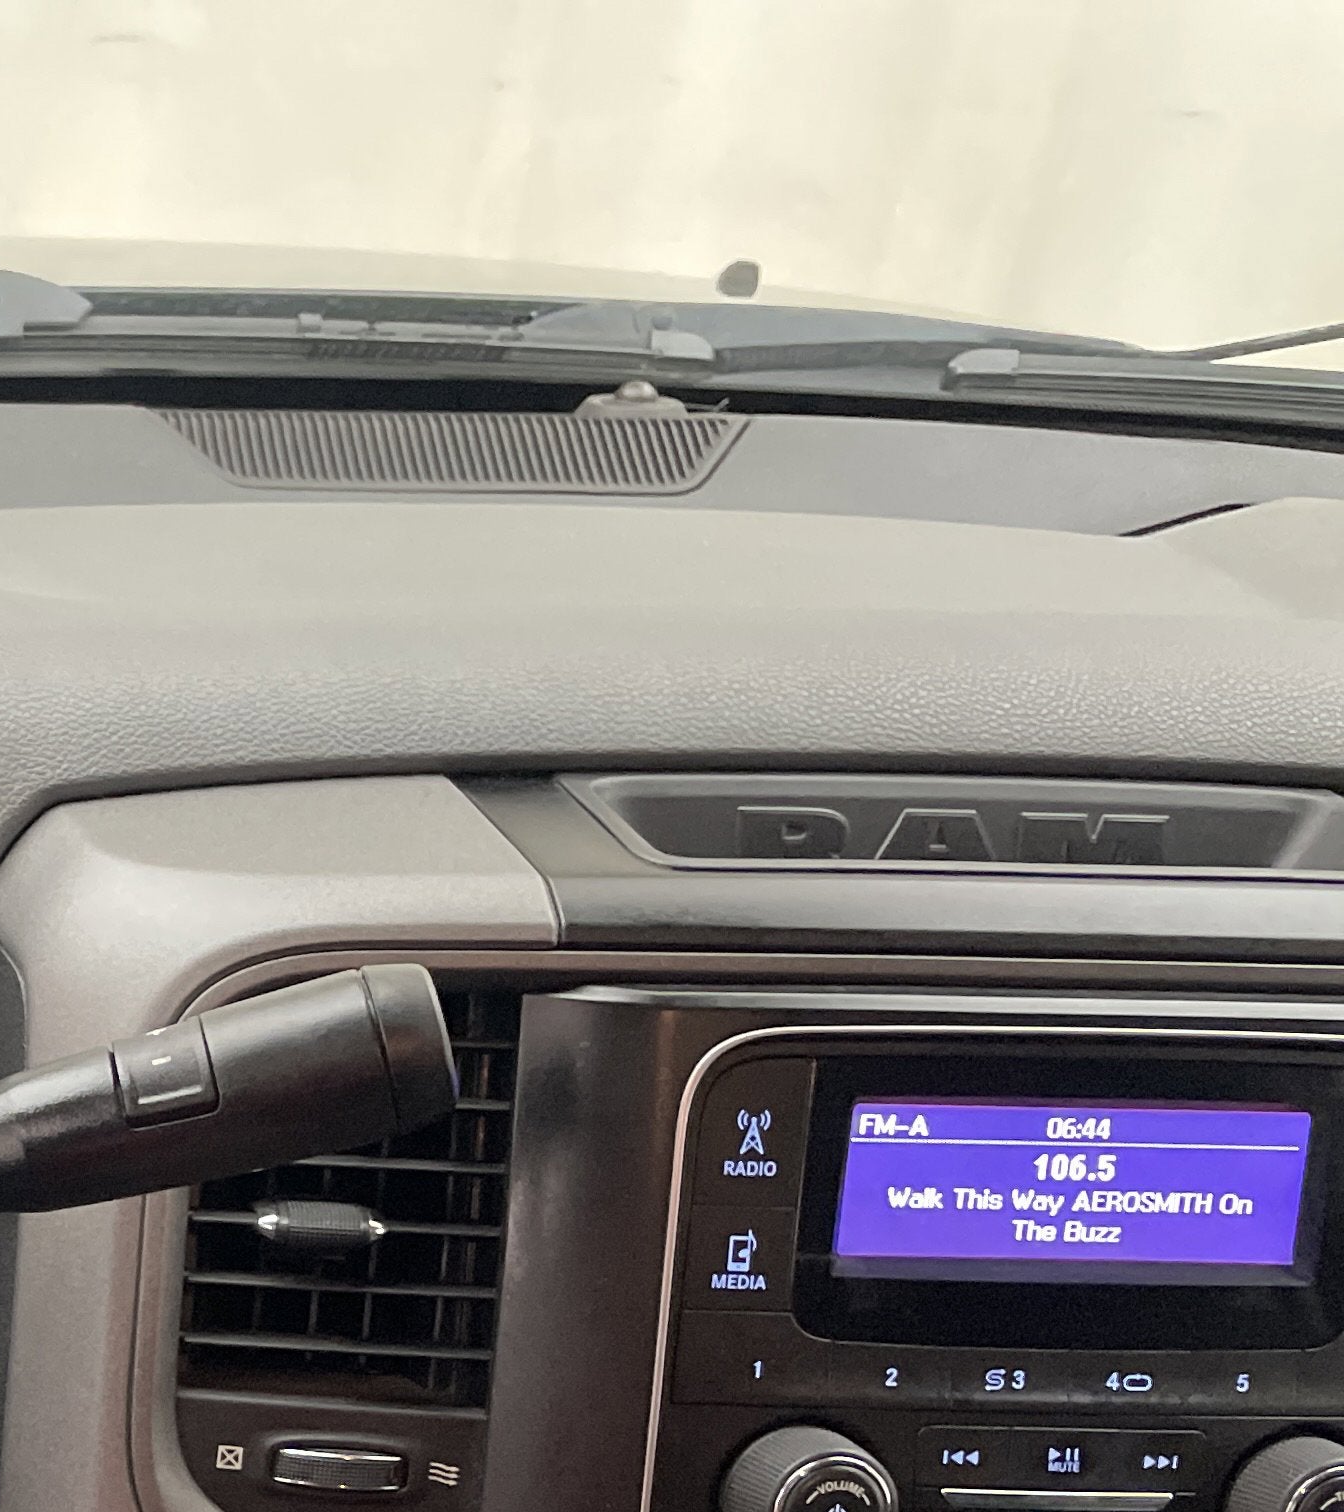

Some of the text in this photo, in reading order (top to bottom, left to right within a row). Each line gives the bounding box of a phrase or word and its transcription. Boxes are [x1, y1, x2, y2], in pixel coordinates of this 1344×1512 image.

[858, 1112, 1112, 1141] FM-A 06:44
[723, 1160, 777, 1177] RADIO
[1032, 1152, 1117, 1183] 106.5
[886, 1186, 1254, 1217] Walk This Way AEROSMITH On
[1012, 1219, 1123, 1245] The Buzz
[711, 1273, 767, 1290] MEDIA
[753, 1360, 762, 1379] 1
[885, 1367, 898, 1387] 2
[1011, 1370, 1026, 1390] 3
[1105, 1371, 1121, 1391] 4
[1236, 1373, 1250, 1393] 5
[1048, 1461, 1080, 1473] MUTE
[816, 1480, 865, 1498] VOLUME
